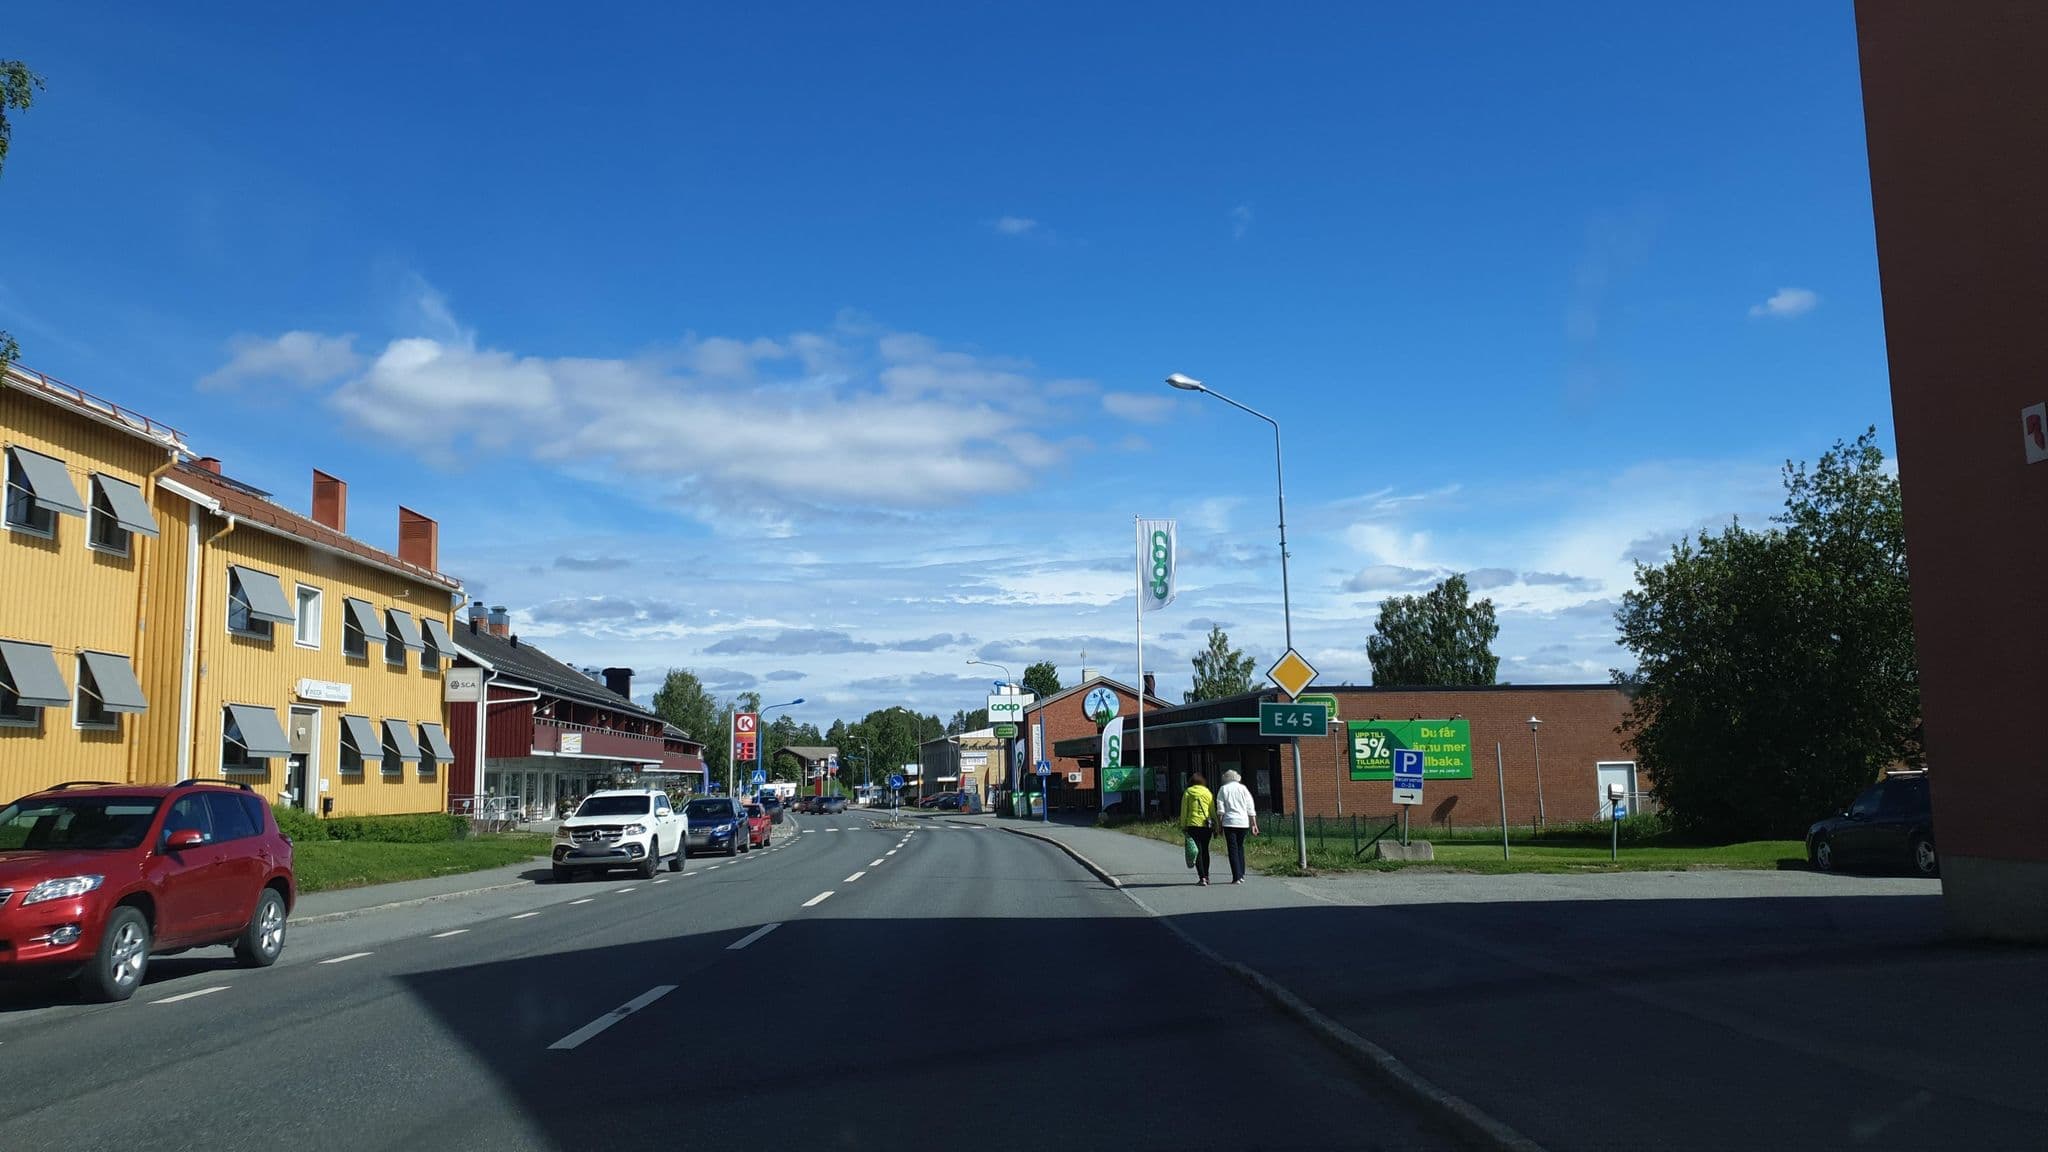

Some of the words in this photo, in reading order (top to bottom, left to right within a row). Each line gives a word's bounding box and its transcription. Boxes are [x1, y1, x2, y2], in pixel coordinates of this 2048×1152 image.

[1149, 530, 1169, 600] coop
[991, 703, 1020, 712] coop
[741, 719, 753, 729] K
[1421, 727, 1437, 738] Du
[1439, 726, 1456, 738] får
[1355, 737, 1390, 759] 5%
[1412, 742, 1441, 752] ännu
[1443, 744, 1467, 752] mer
[1403, 752, 1417, 772] P
[1424, 756, 1464, 767] llbaka.
